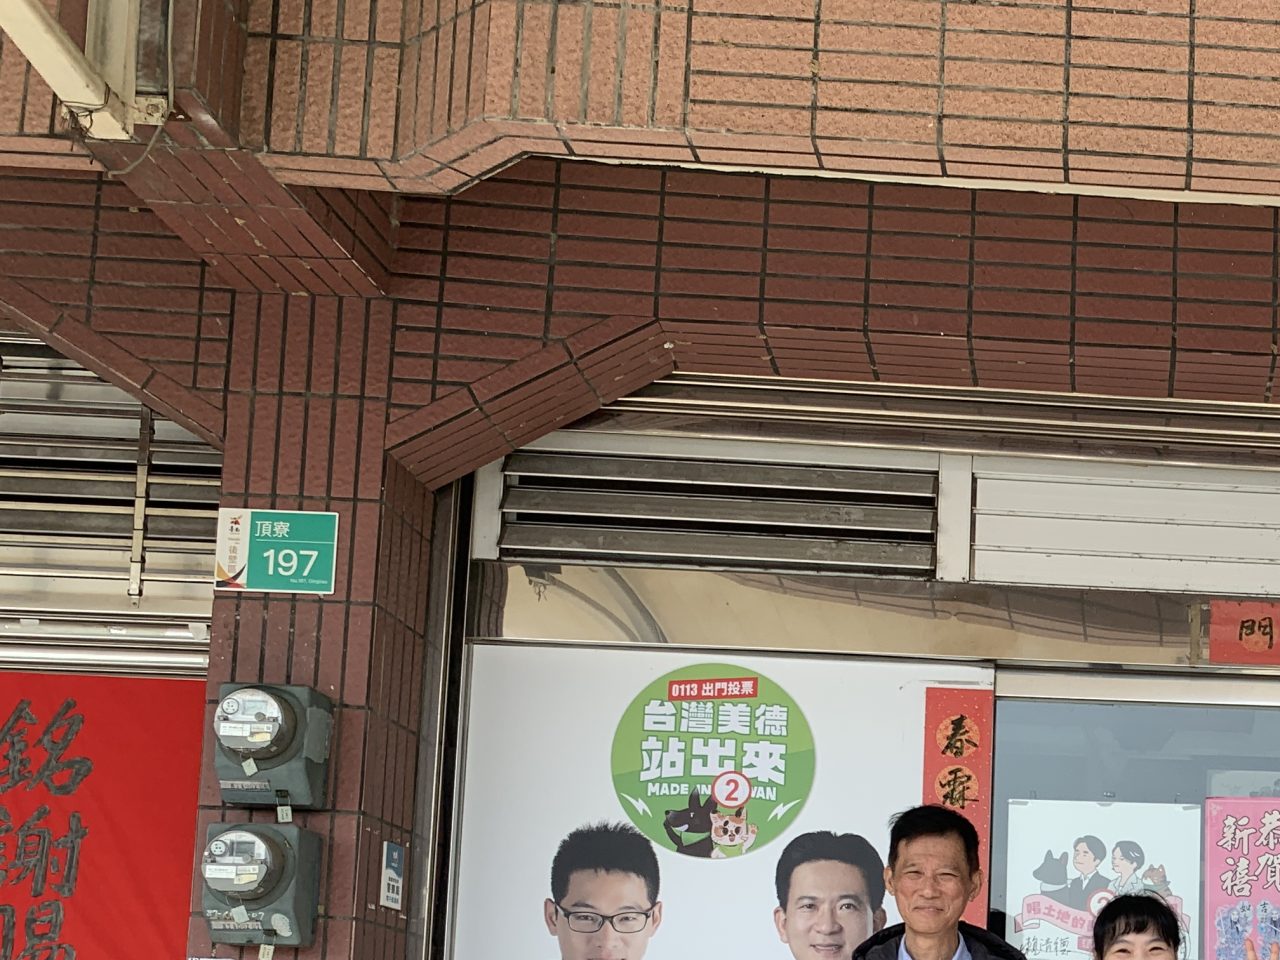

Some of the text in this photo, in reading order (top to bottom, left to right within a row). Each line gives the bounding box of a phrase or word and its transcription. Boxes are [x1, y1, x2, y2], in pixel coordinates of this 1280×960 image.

[255, 521, 290, 538] 頂寮
[263, 549, 319, 577] 197
[672, 681, 754, 696] 0113 出門投票
[643, 700, 788, 736] 台灣美德
[639, 736, 786, 785] 站出來
[647, 782, 689, 796] MADE
[725, 779, 739, 801] 2
